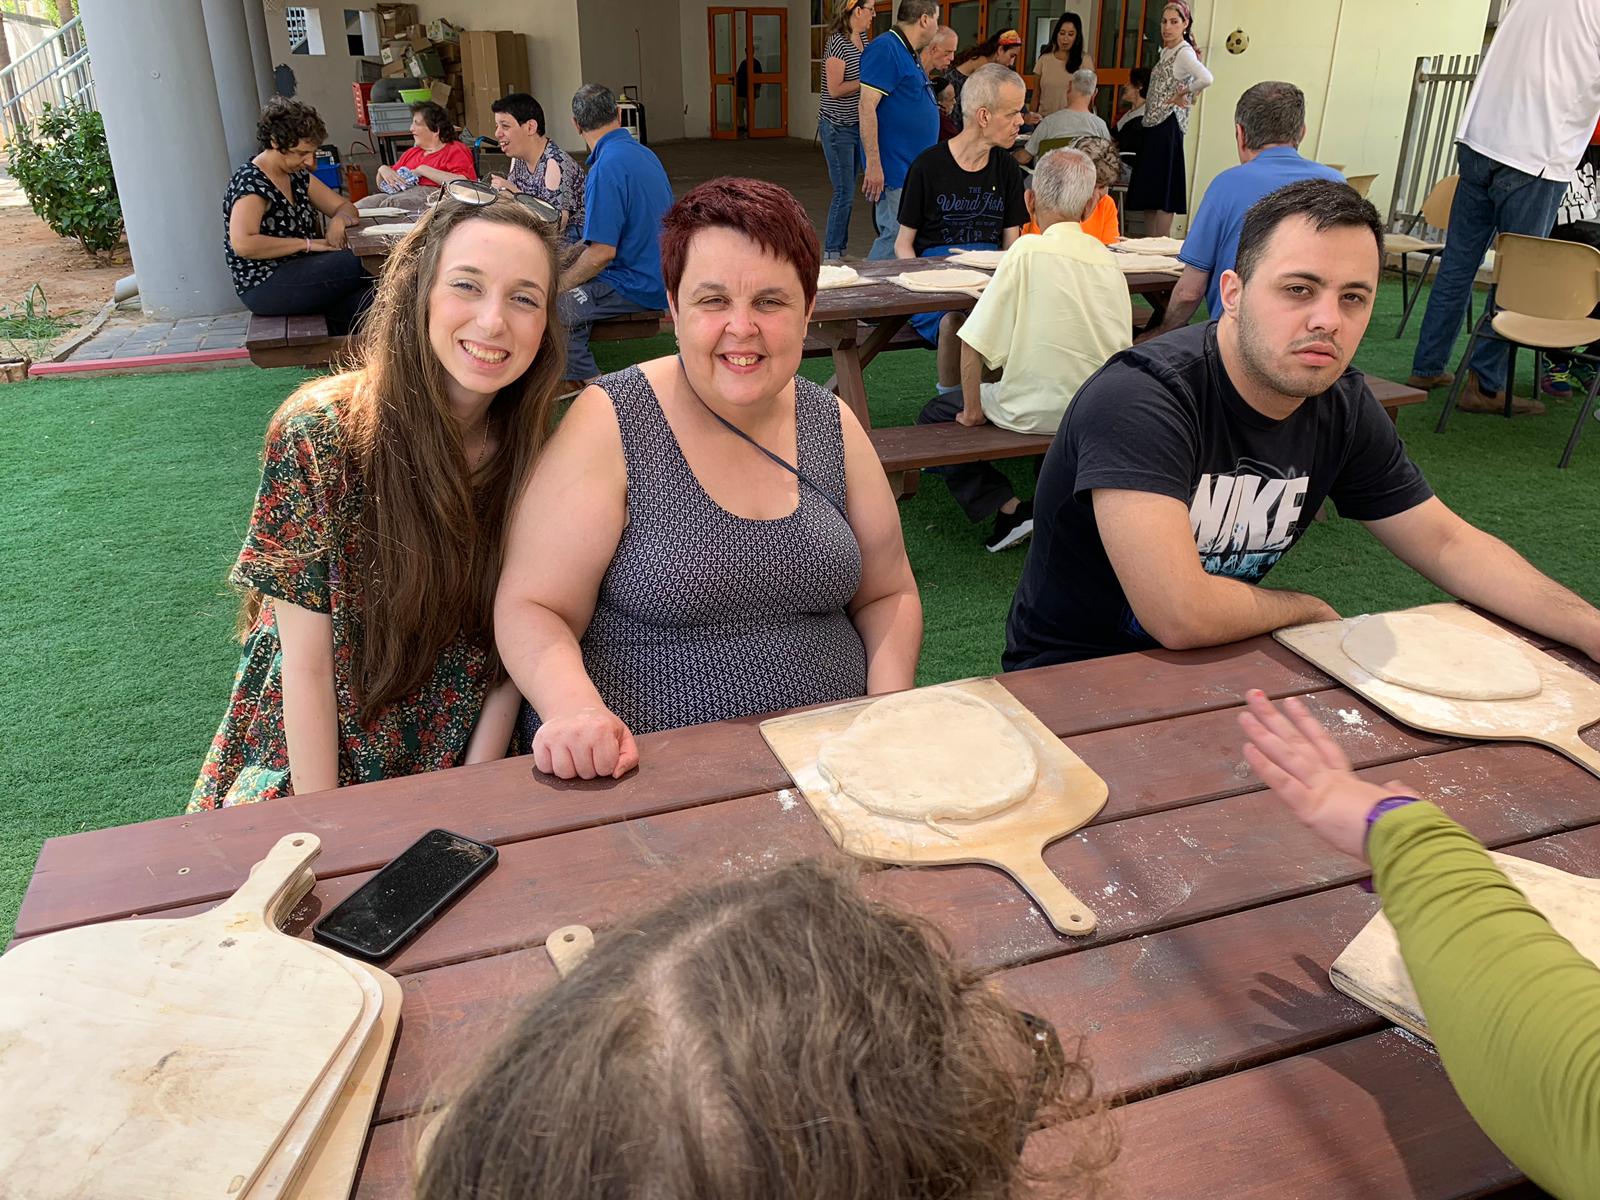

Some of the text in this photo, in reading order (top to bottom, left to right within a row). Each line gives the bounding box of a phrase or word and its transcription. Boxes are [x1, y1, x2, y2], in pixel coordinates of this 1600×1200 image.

[936, 191, 1005, 212] Weird Fish
[1189, 473, 1310, 553] NIKE
